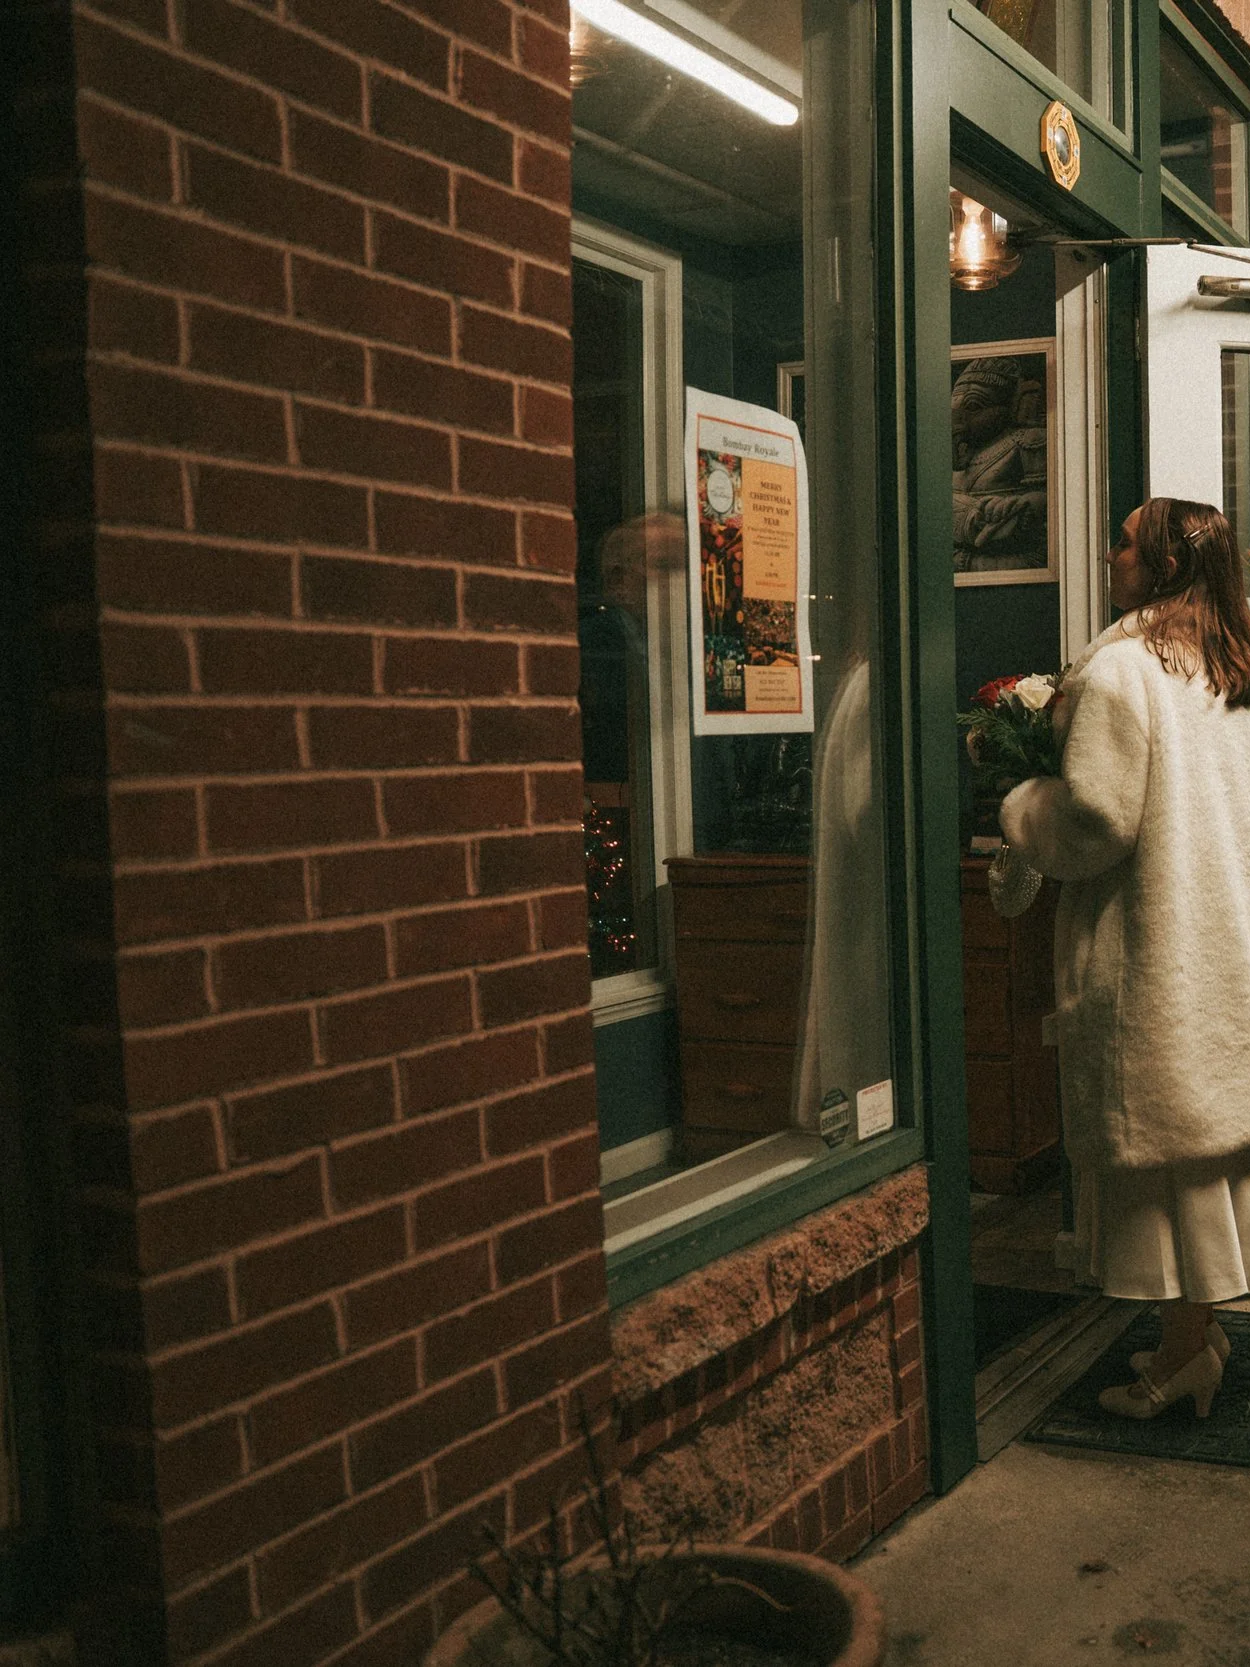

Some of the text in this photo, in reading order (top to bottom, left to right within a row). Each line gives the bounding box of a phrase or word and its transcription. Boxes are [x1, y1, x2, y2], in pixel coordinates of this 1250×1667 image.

[722, 436, 780, 458] Bombay Royale
[760, 481, 782, 491] MERRY
[752, 503, 774, 514] HAPPY
[763, 516, 780, 526] YEAR
